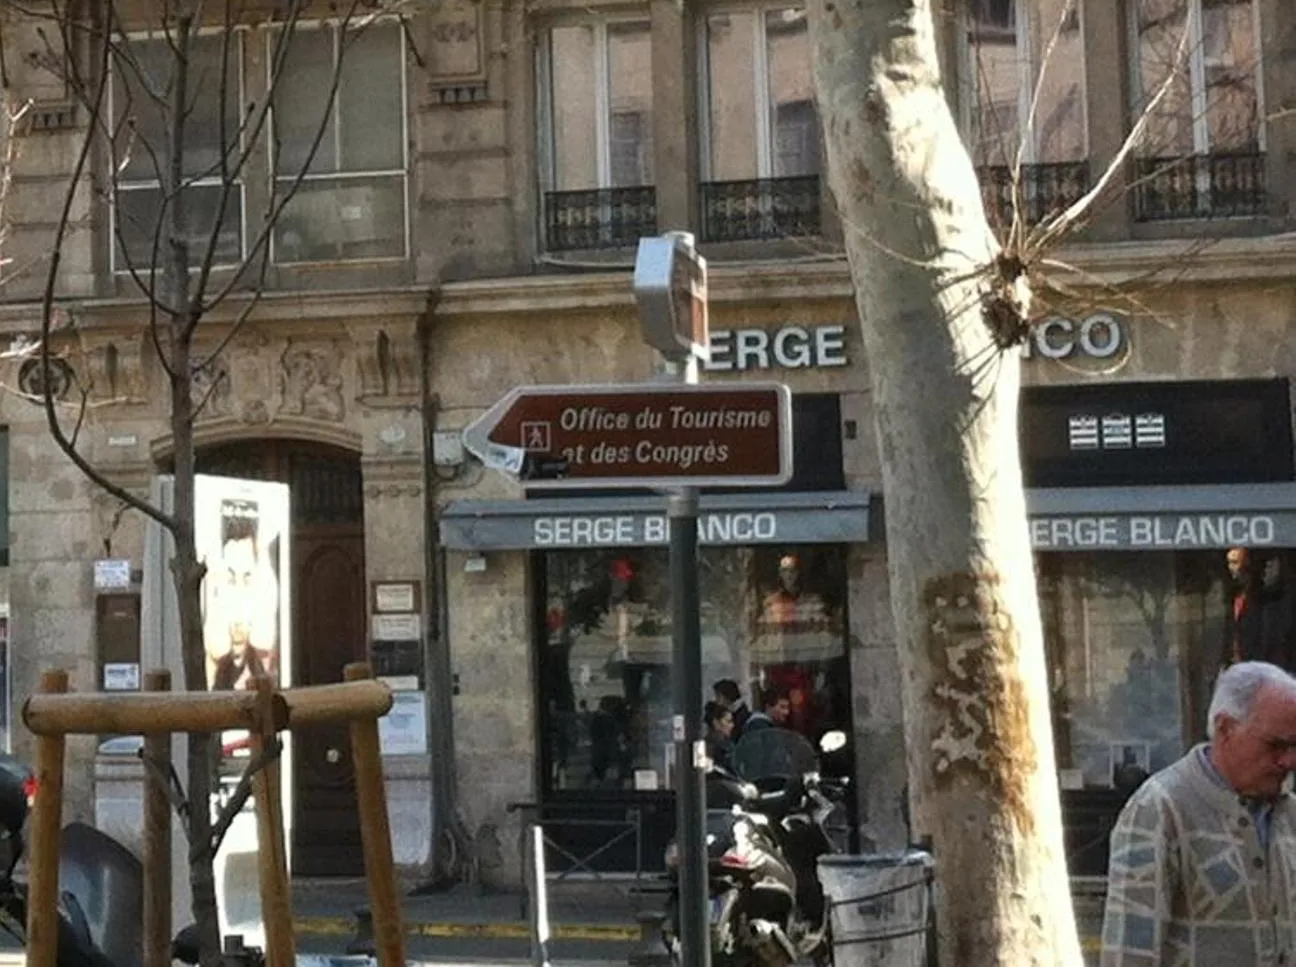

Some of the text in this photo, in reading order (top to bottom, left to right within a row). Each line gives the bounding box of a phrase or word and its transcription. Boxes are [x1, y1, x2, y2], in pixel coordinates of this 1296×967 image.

[705, 324, 846, 370] ERGE
[561, 405, 771, 431] Office du Tourisme
[591, 440, 629, 463] des
[636, 439, 729, 469] Congrès
[534, 516, 633, 544] SERGE
[1032, 515, 1274, 547] ERGE BLANCO
